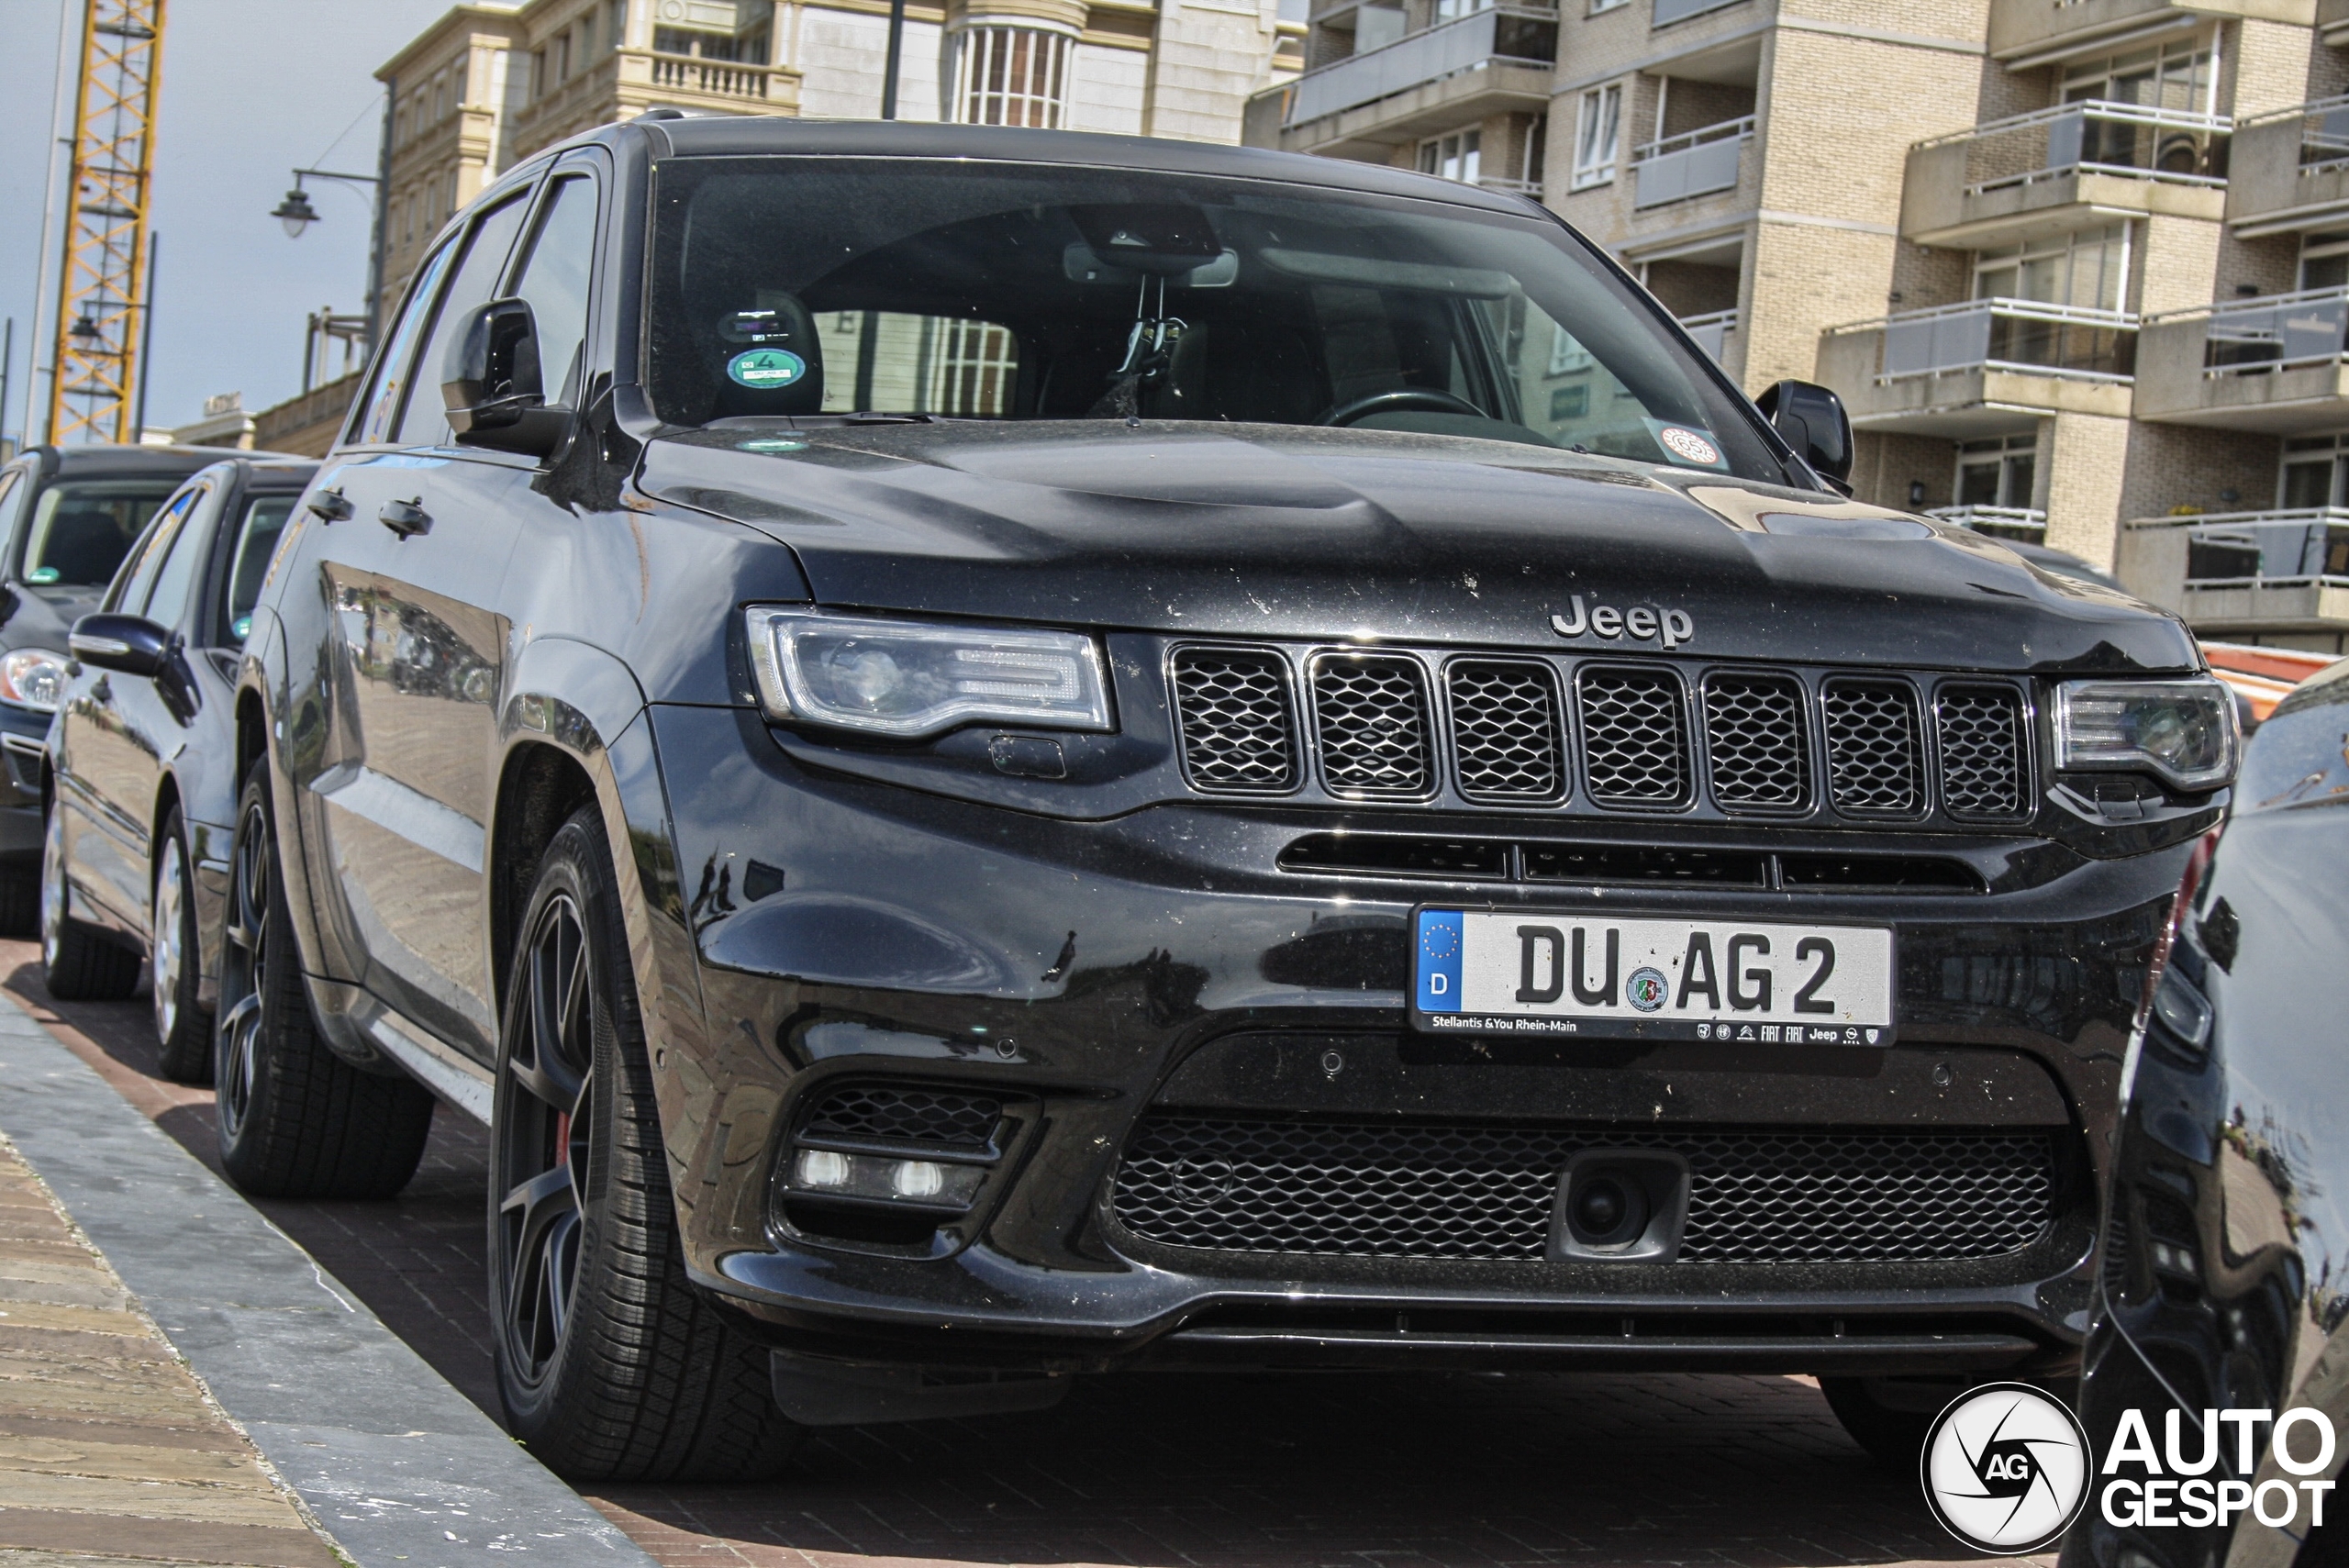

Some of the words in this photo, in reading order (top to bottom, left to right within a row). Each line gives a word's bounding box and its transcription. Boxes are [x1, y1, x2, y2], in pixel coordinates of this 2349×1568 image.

[757, 354, 775, 369] 4
[1676, 438, 1703, 454] 65
[1550, 595, 1693, 651] Jeep
[1516, 925, 1620, 1006] DU
[1675, 931, 1772, 1011] AG
[1794, 936, 1835, 1013] 2
[1431, 973, 1448, 995] D
[1432, 1016, 1483, 1029] Stellantis
[1516, 1018, 1577, 1032] Rhein-Main
[1761, 1025, 1780, 1042] FIAT
[1786, 1026, 1804, 1043] FIAT
[1809, 1028, 1838, 1042] Jeep
